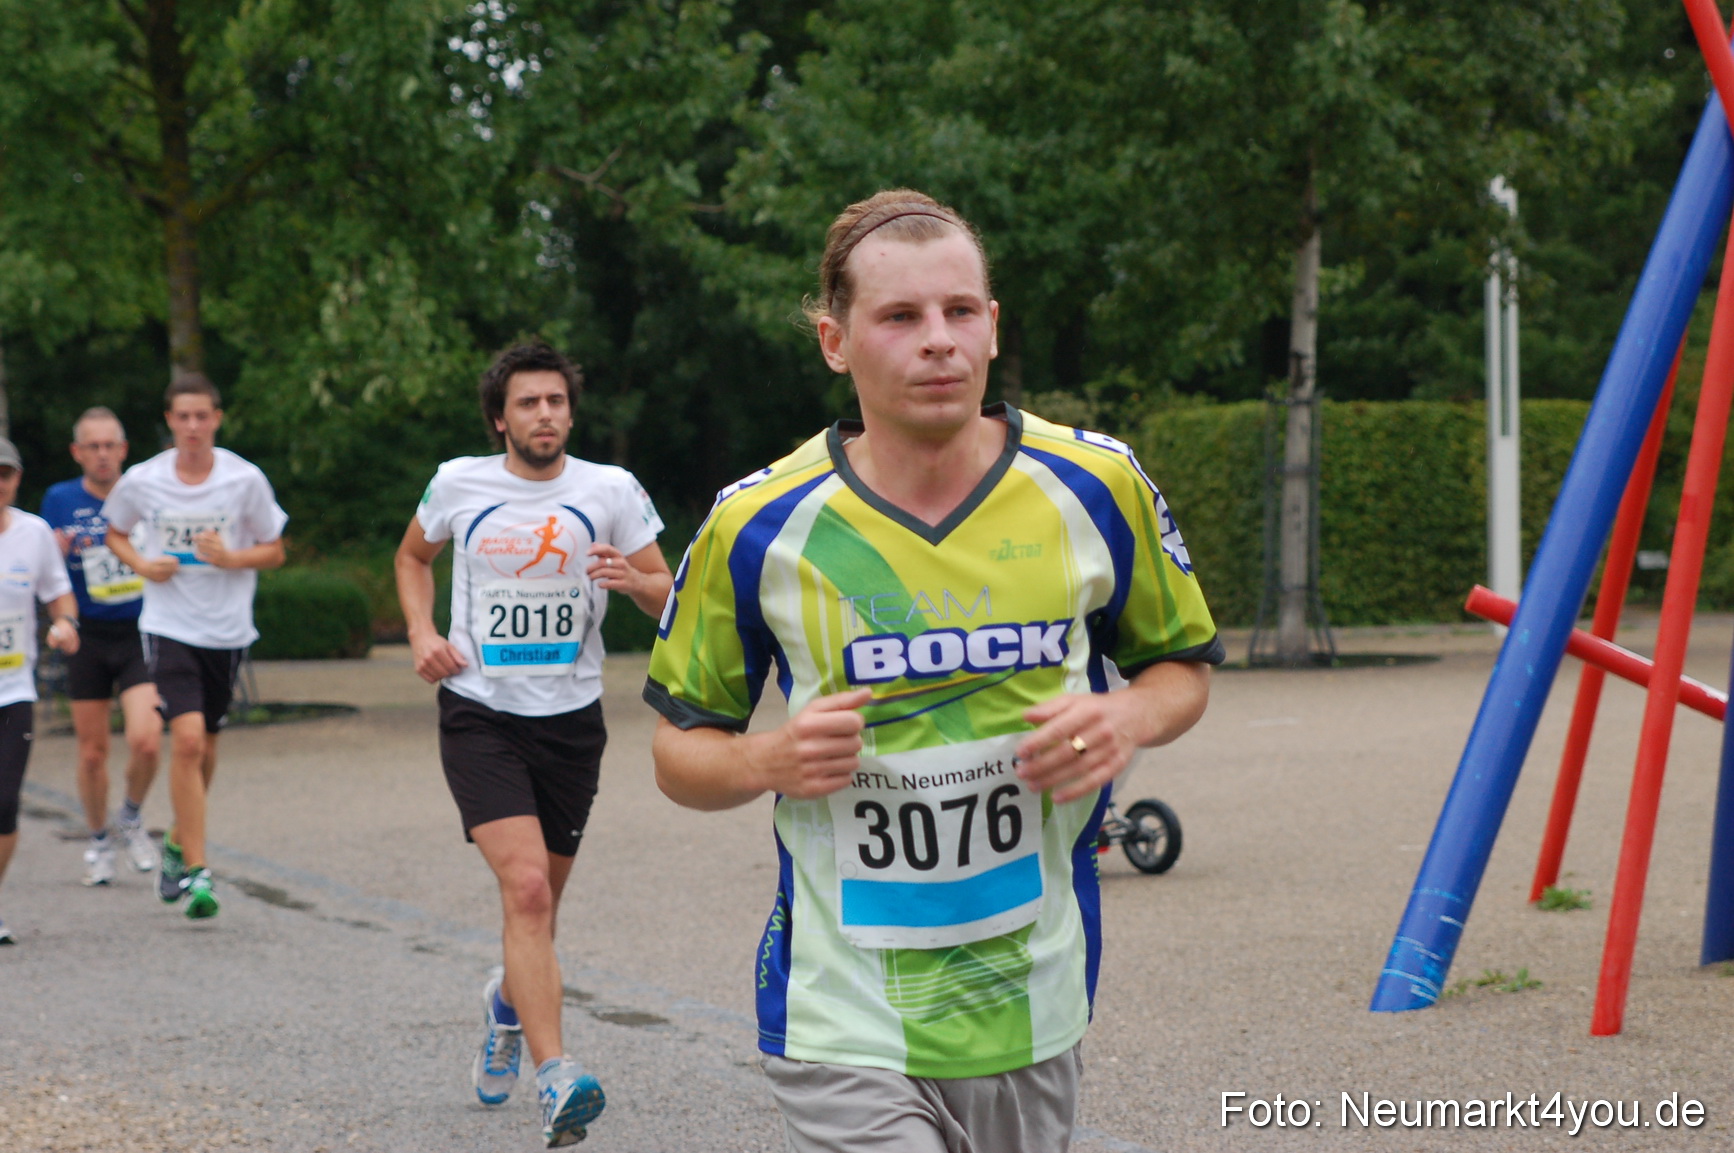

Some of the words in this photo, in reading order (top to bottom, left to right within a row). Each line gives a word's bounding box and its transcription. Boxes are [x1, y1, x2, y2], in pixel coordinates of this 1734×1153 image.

[476, 544, 534, 555] FunRun
[516, 589, 566, 598] Neumarkt
[838, 585, 993, 628] TEAM
[490, 603, 573, 638] 2018
[499, 647, 560, 663] Christian
[843, 618, 1075, 685] BOCK
[901, 759, 1005, 790] Neumarkt
[854, 784, 1023, 871] 3076
